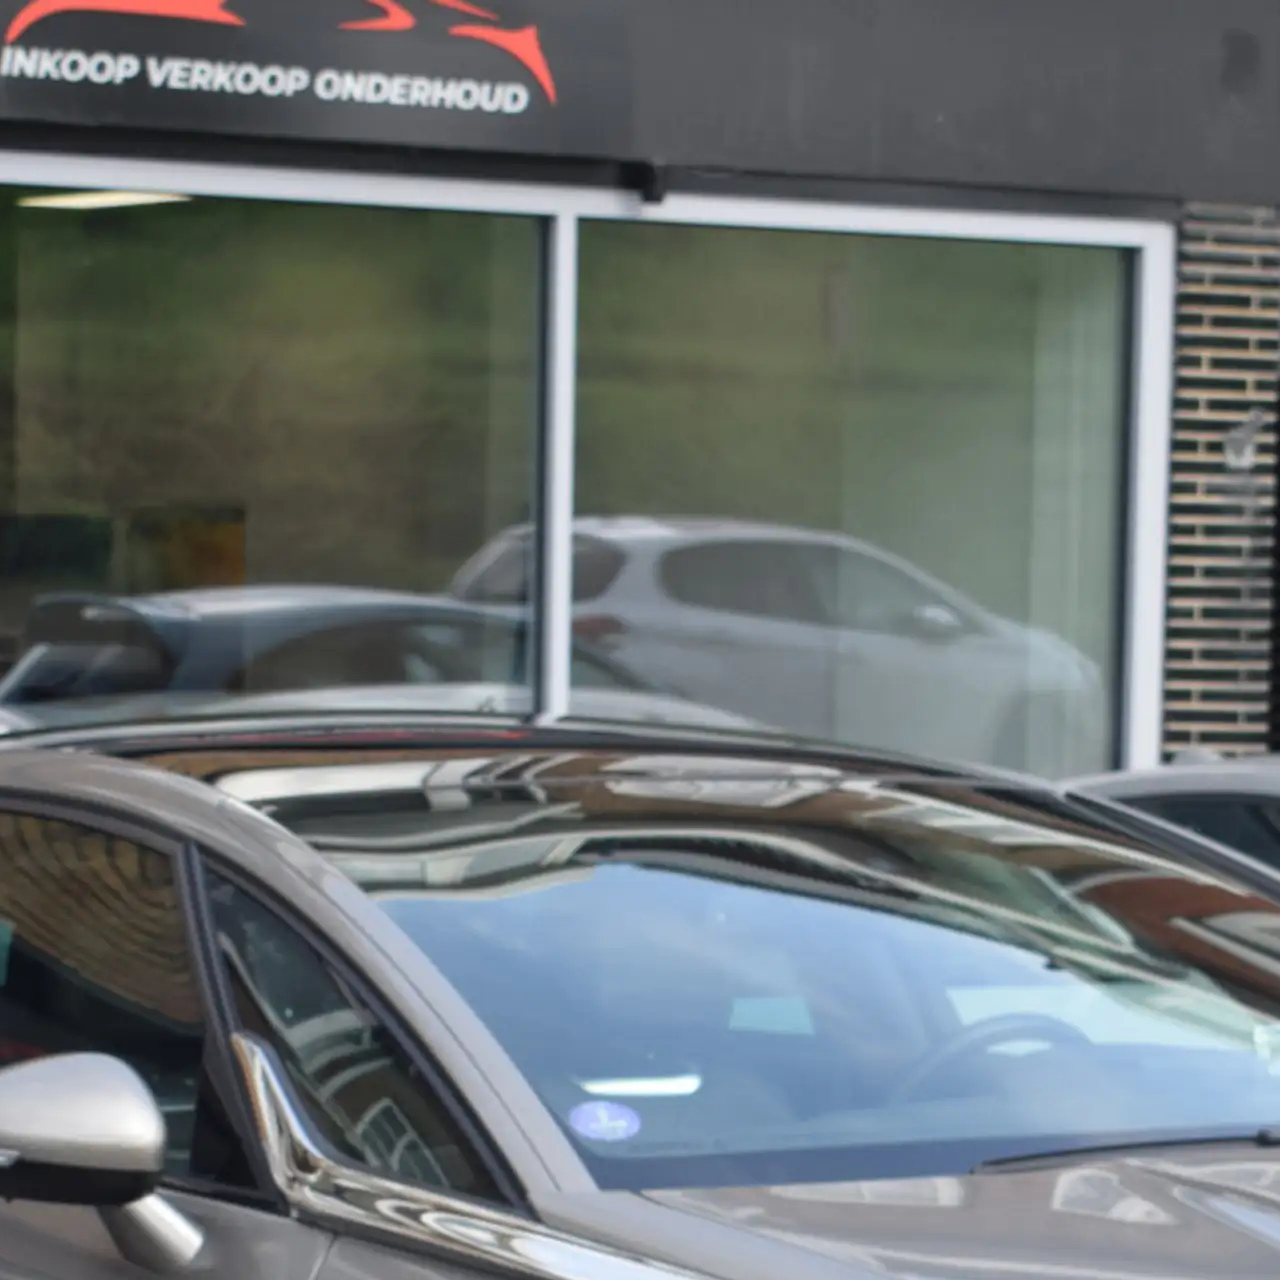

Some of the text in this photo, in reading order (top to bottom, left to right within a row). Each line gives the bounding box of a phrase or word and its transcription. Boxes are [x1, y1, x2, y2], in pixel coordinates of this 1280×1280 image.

[0, 45, 529, 113] INKOOP VERKOOP ONDERHOUD
